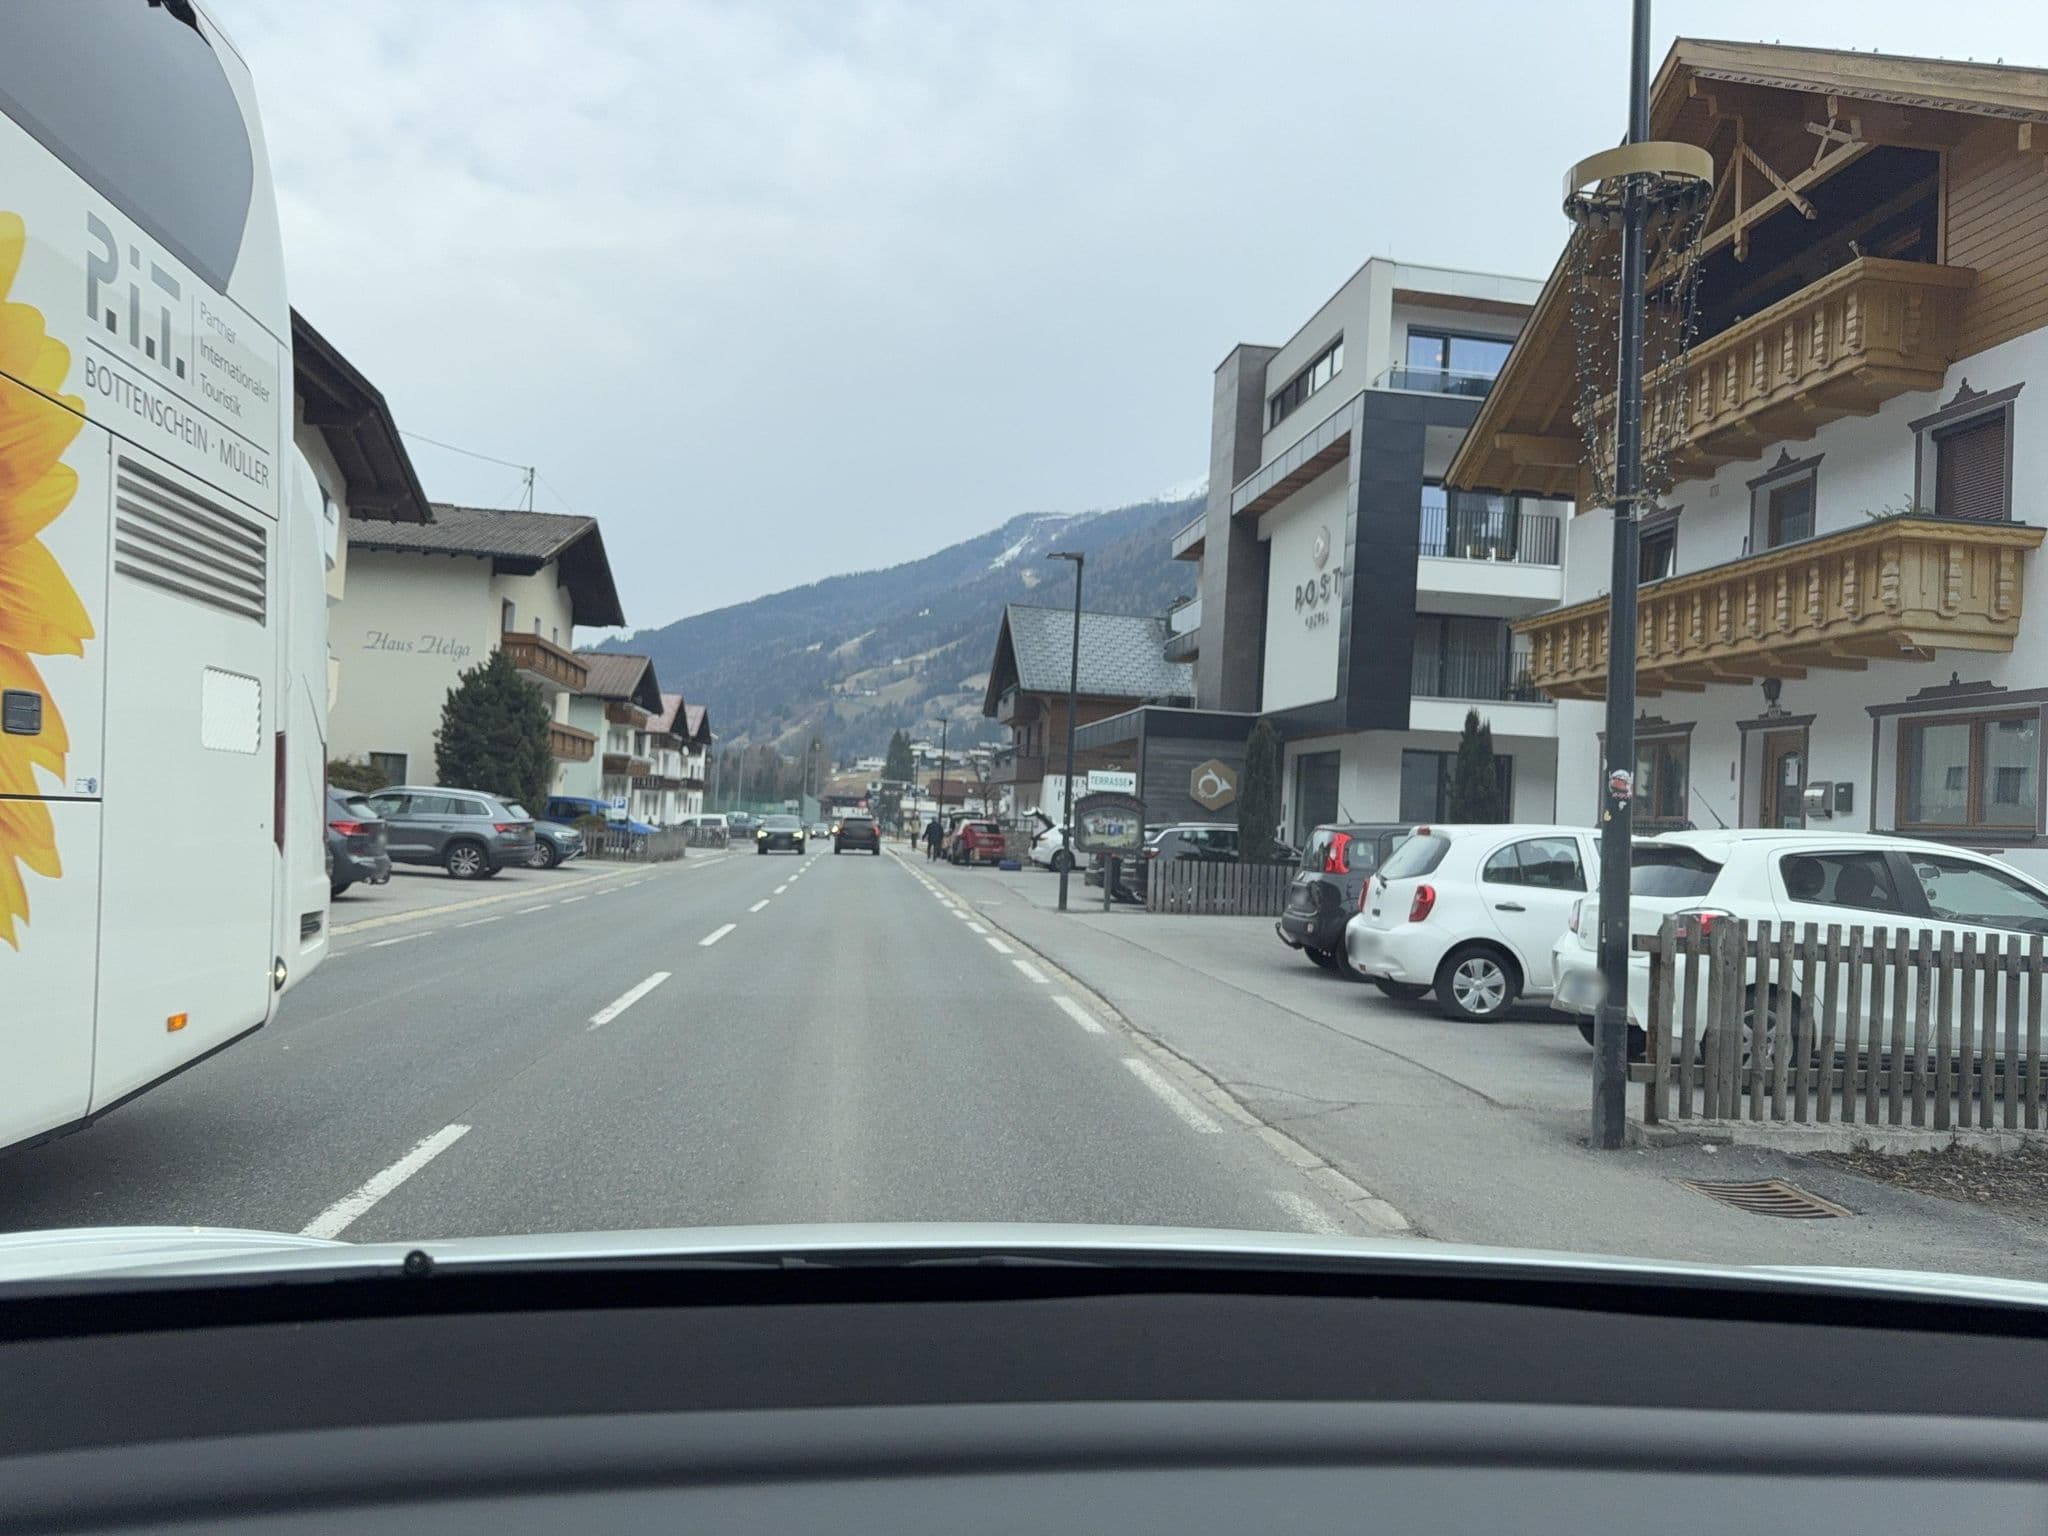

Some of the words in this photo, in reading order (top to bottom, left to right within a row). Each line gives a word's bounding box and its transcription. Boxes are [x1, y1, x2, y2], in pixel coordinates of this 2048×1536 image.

[200, 301, 237, 345] Partner
[200, 335, 270, 403] Internationaler
[200, 372, 242, 418] Touristik
[85, 355, 208, 455] BOTTENSCHEIN
[219, 437, 270, 490] MÜLLER
[1294, 565, 1343, 612] POST
[362, 630, 414, 651] Haus
[416, 635, 473, 662] Helga
[1090, 774, 1127, 787] TERRASSE
